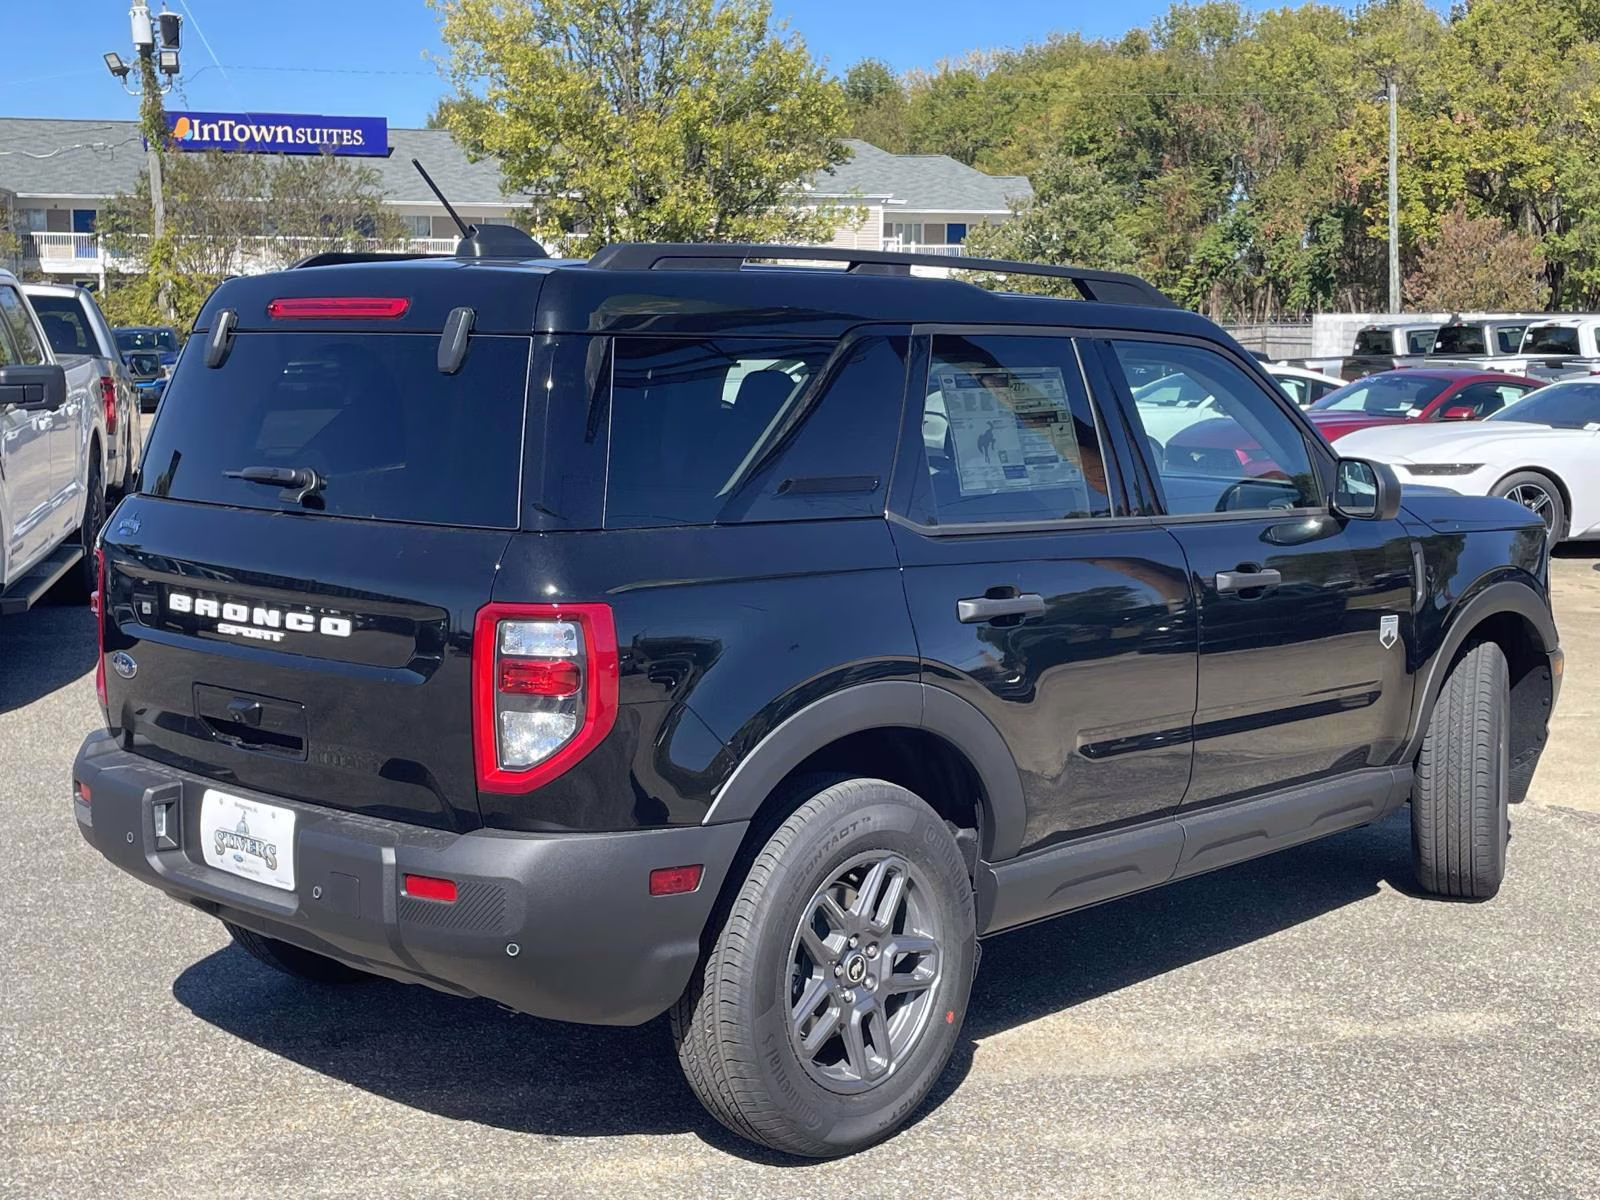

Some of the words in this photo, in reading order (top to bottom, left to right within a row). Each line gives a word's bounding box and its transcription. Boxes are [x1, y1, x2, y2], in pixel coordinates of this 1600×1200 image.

[169, 593, 352, 637] BRONCO
[217, 623, 285, 642] SPORT
[214, 829, 278, 871] STIVERS
